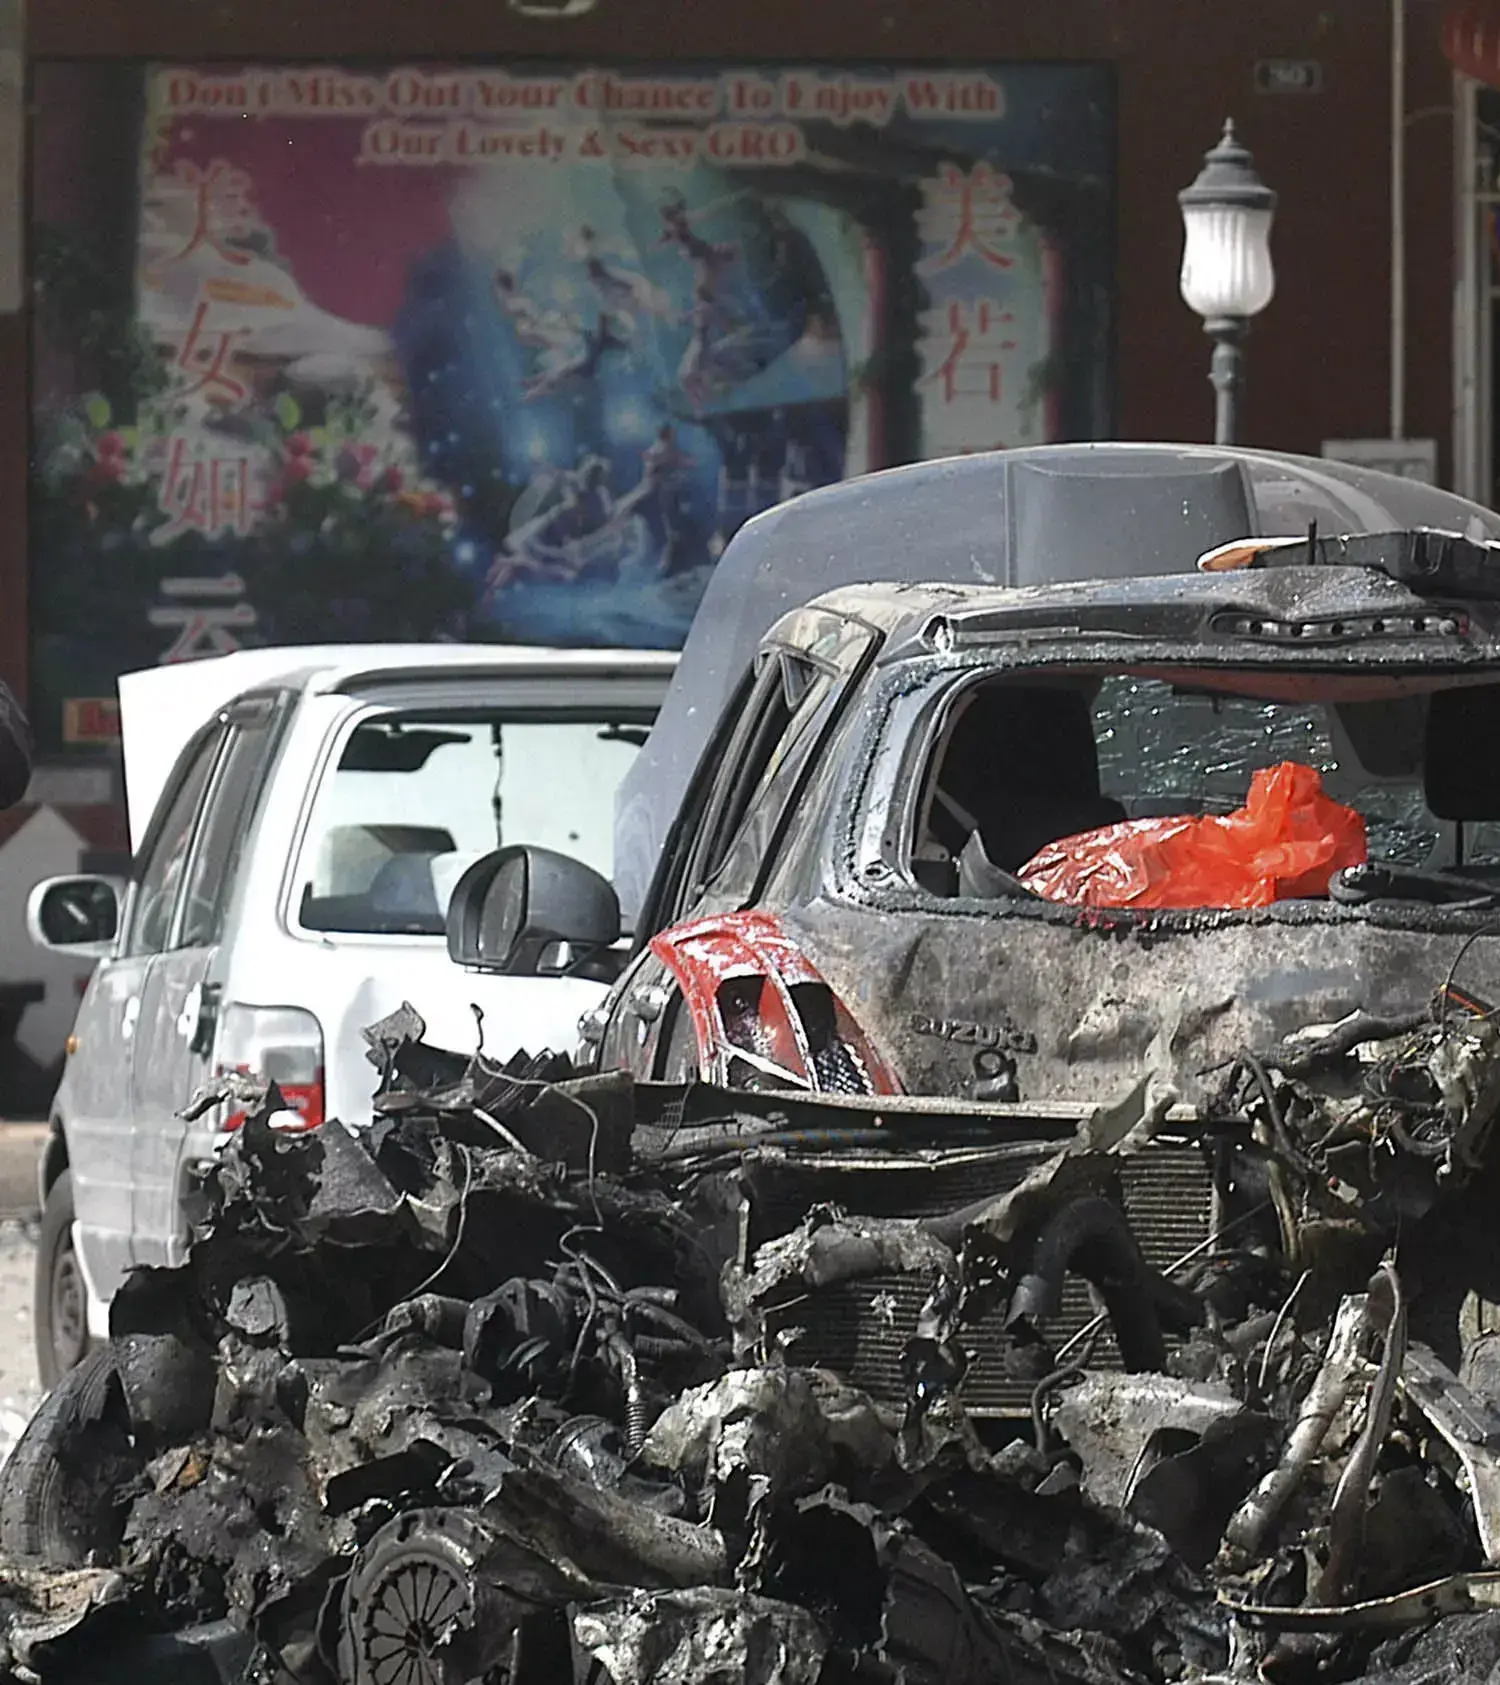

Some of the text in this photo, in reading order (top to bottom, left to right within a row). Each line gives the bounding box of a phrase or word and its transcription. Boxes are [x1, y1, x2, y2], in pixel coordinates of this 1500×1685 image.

[169, 75, 999, 118] Don't Miss Out Your Chance To Enjoy With
[370, 126, 797, 163] Our Lovely & Sexy GRO
[914, 163, 1020, 453] 美若
